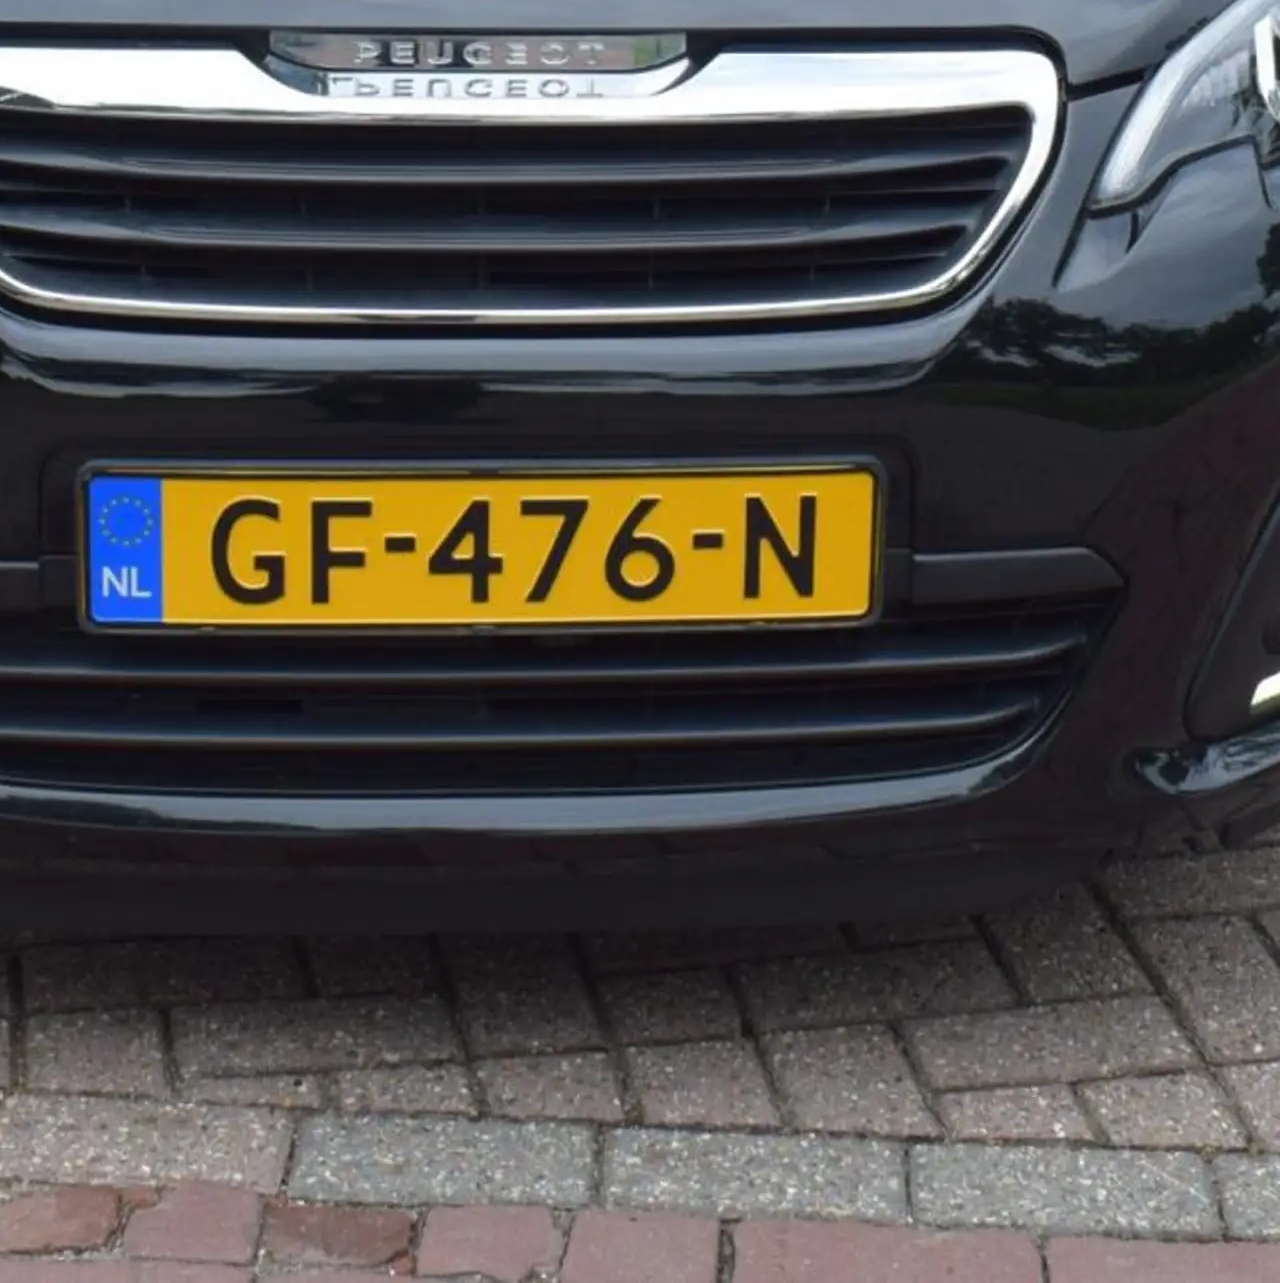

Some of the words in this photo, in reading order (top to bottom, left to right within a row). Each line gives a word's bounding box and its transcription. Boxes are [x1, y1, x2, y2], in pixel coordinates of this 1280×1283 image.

[354, 41, 605, 66] PEUGEOT
[101, 567, 152, 598] NL
[210, 494, 817, 604] GF-476-N
